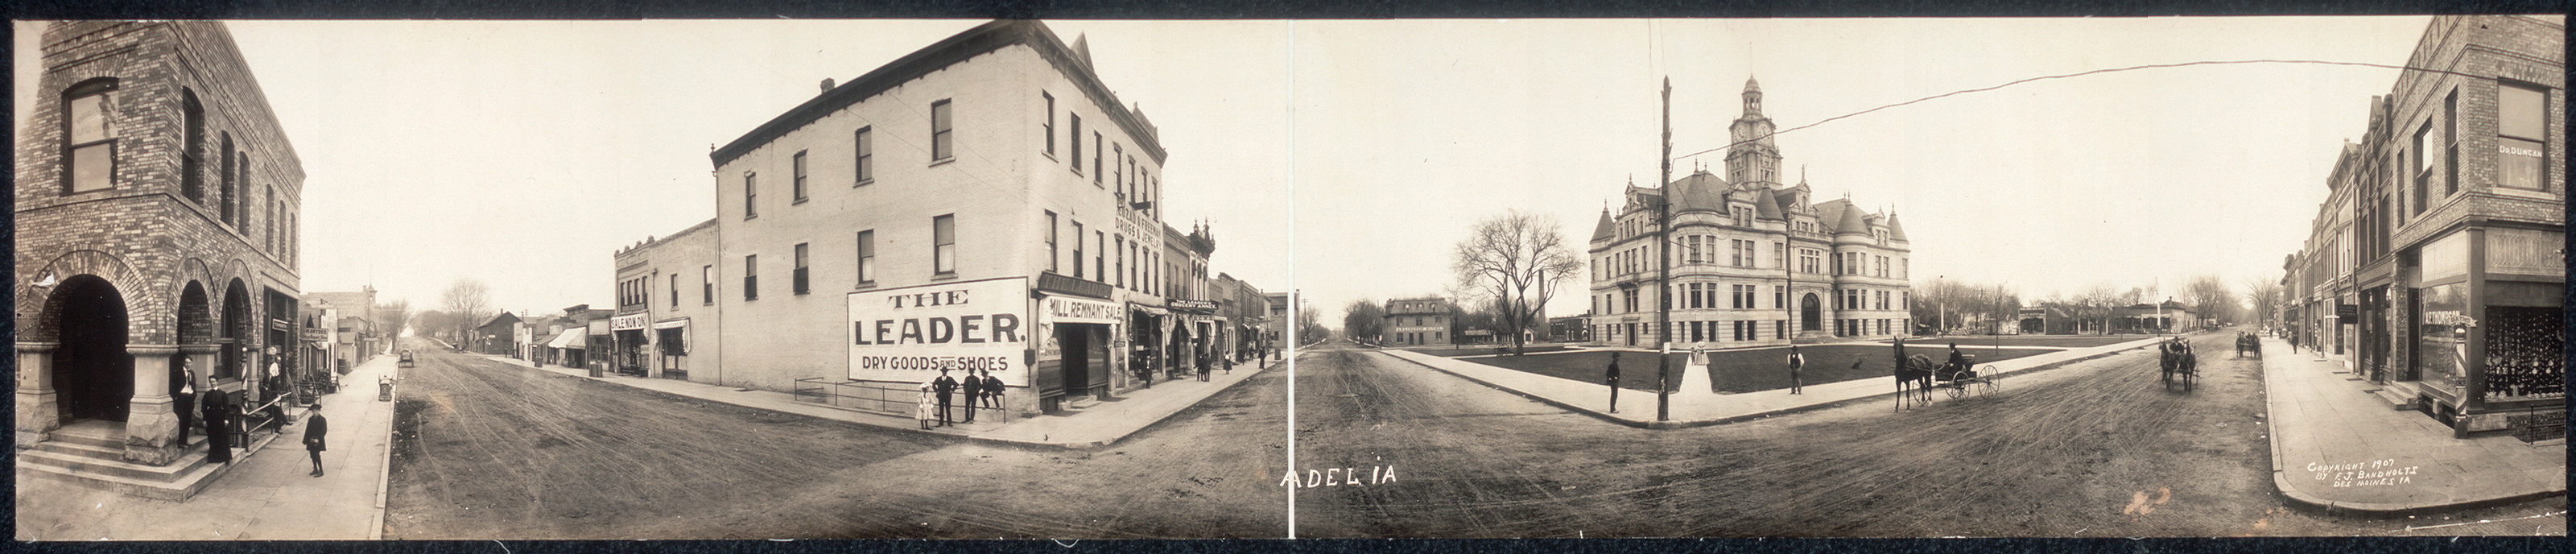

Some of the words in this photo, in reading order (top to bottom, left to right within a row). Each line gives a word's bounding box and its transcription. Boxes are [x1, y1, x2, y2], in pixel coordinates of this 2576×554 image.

[2511, 147, 2542, 157] DUNCAN
[1115, 217, 1136, 237] DRUGS
[1137, 228, 1141, 239] &
[1044, 274, 1069, 291] THE
[1070, 279, 1111, 296] LEADER
[888, 289, 969, 309] THE
[1050, 298, 1068, 317] MILL
[1070, 301, 1104, 320] REMNANT
[1105, 305, 1121, 320] SALE
[611, 317, 625, 329] SALE
[625, 316, 637, 329] NOW
[637, 316, 646, 328] ON
[855, 312, 1026, 345] LEADER.
[863, 356, 888, 370] DRY
[890, 355, 939, 370] GOODS
[939, 358, 956, 370] AND
[957, 356, 1009, 370] SHOES
